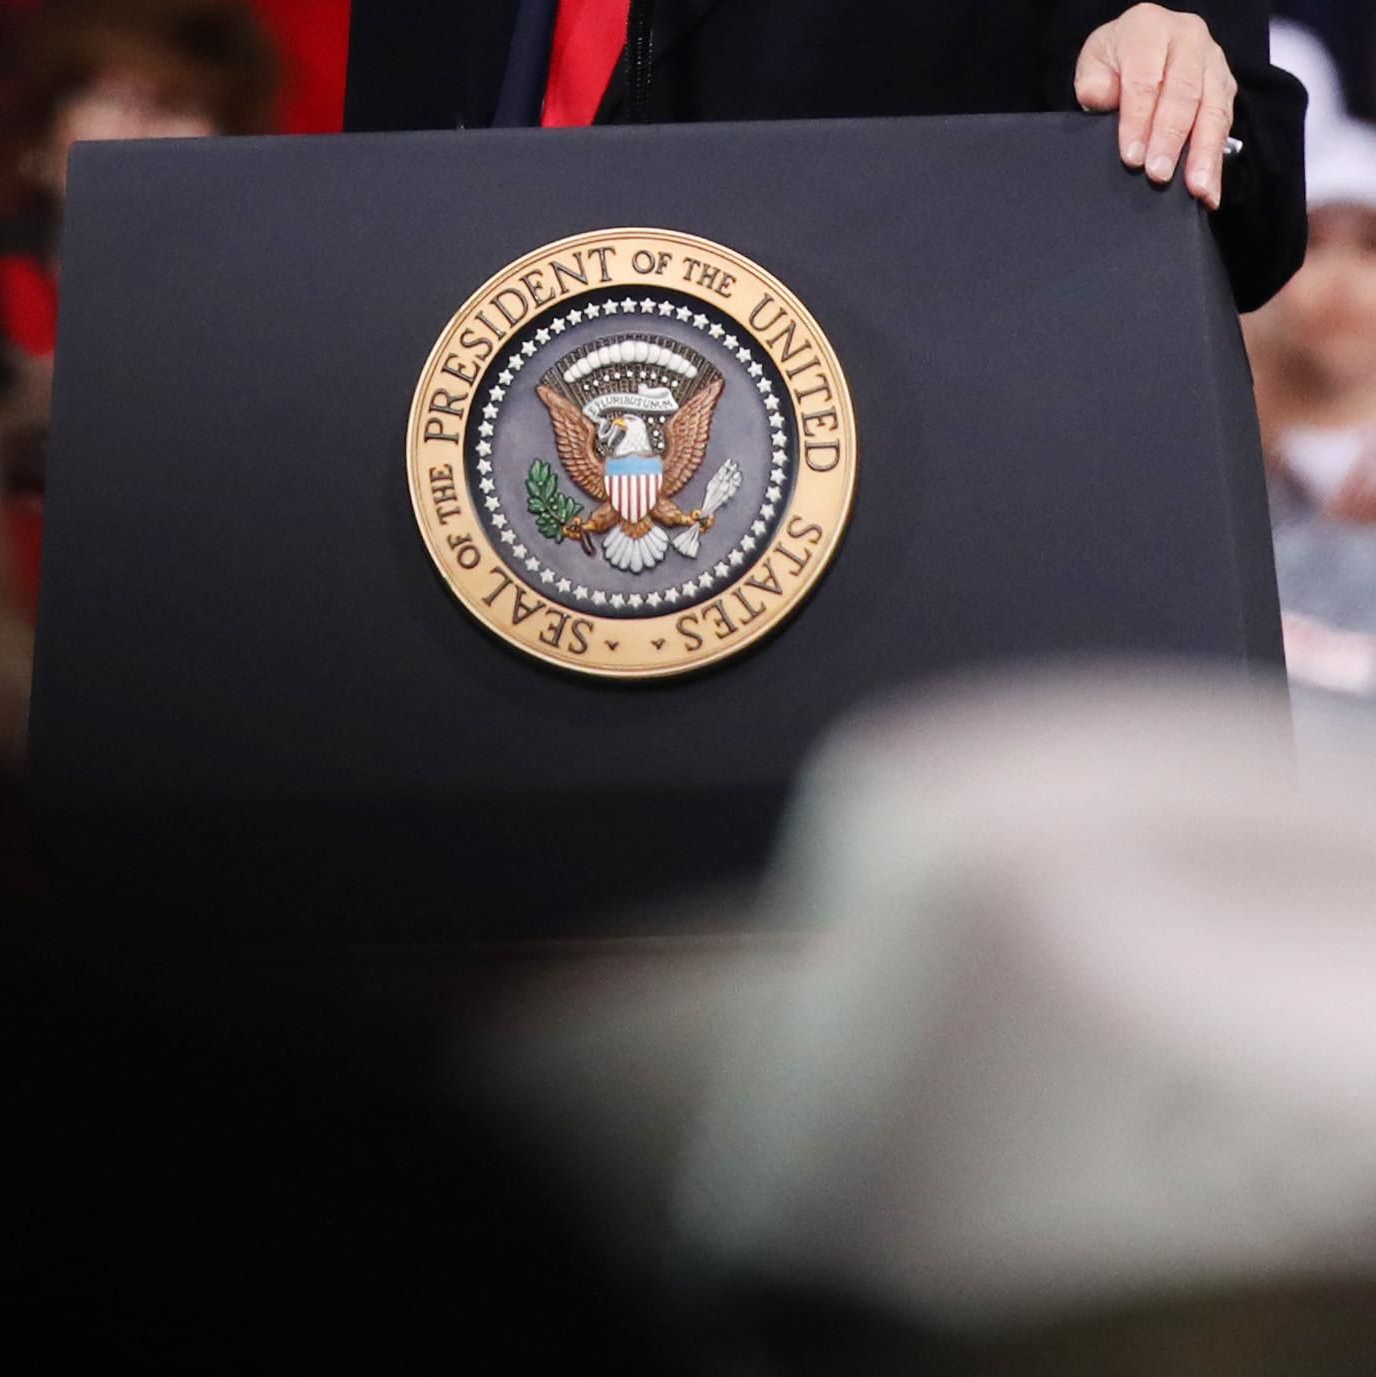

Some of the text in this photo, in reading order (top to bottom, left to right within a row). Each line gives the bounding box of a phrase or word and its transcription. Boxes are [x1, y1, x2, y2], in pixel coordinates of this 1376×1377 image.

[424, 246, 840, 655] SEAL OF THE PRESIDENT OF THE UNITED STATES
